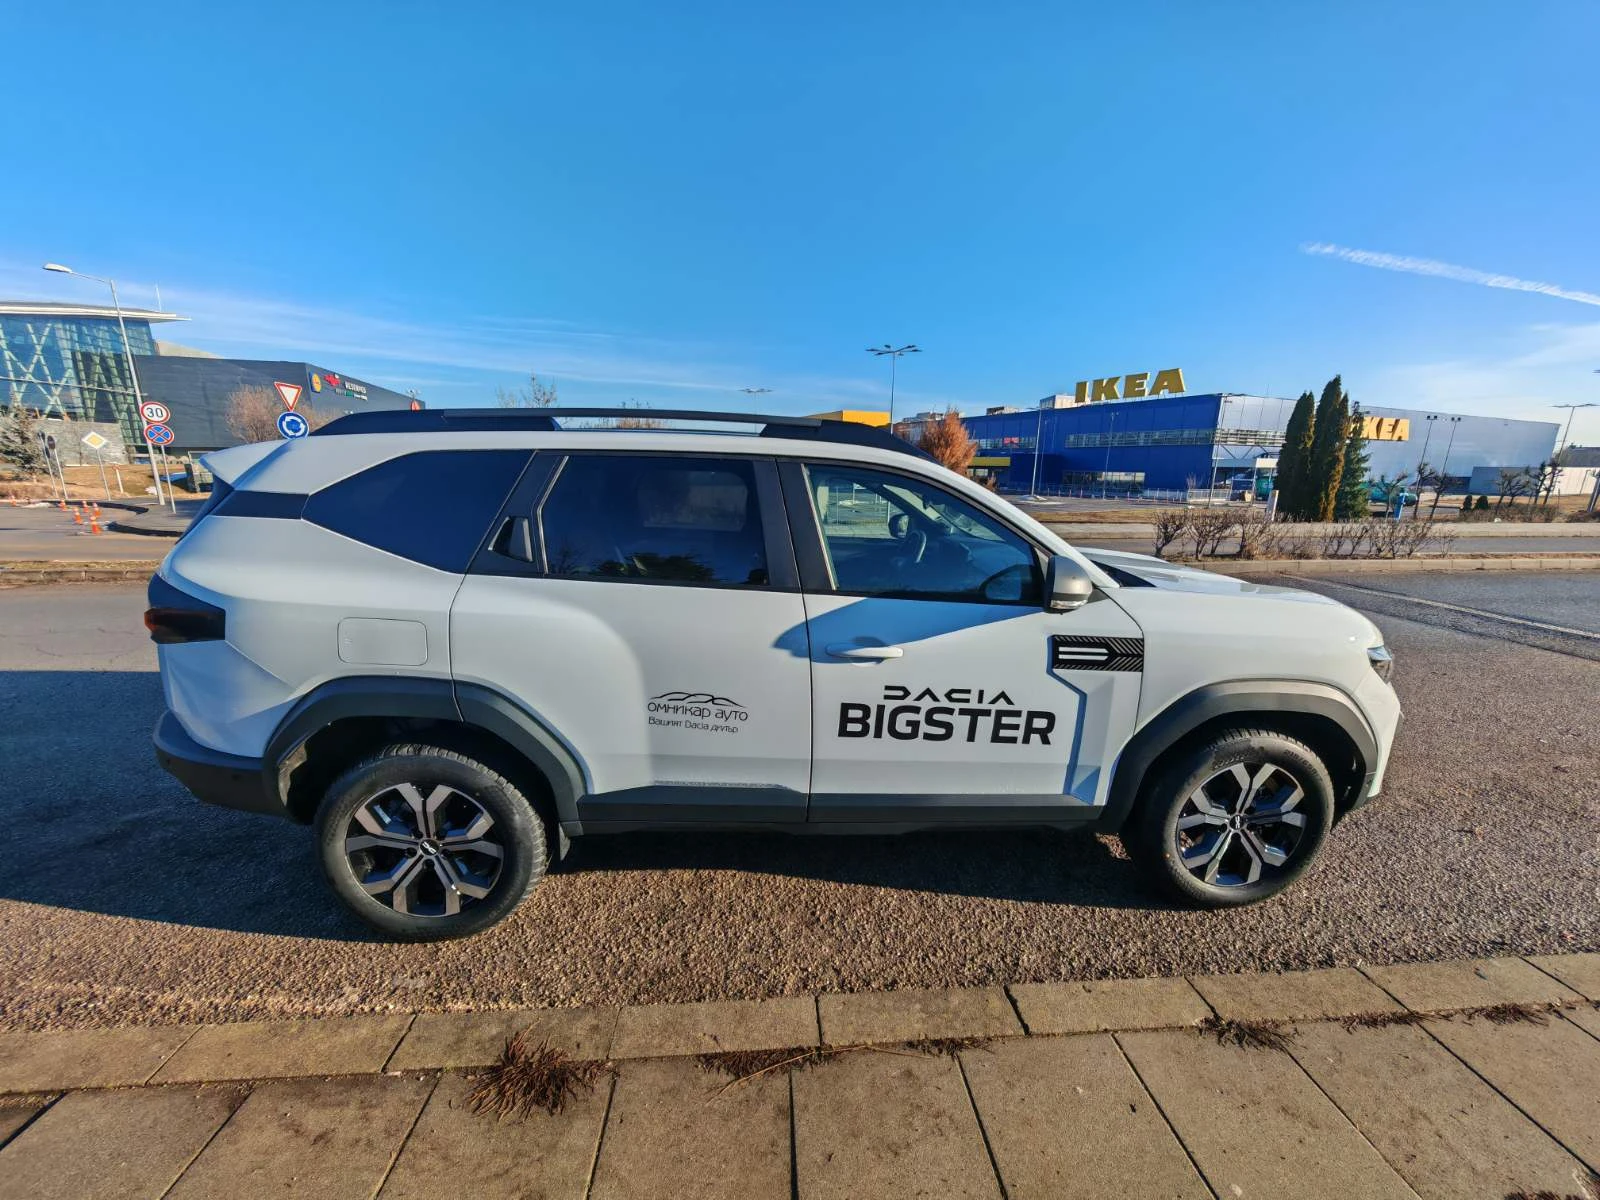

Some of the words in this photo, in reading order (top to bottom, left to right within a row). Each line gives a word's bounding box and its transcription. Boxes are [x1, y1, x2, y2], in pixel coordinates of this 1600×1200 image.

[1074, 367, 1186, 404] IKEA
[146, 407, 164, 418] 30
[883, 685, 1015, 706] DACIA
[714, 709, 749, 722] ауто
[837, 702, 1056, 745] BIGSTER
[684, 719, 709, 730] Dacia
